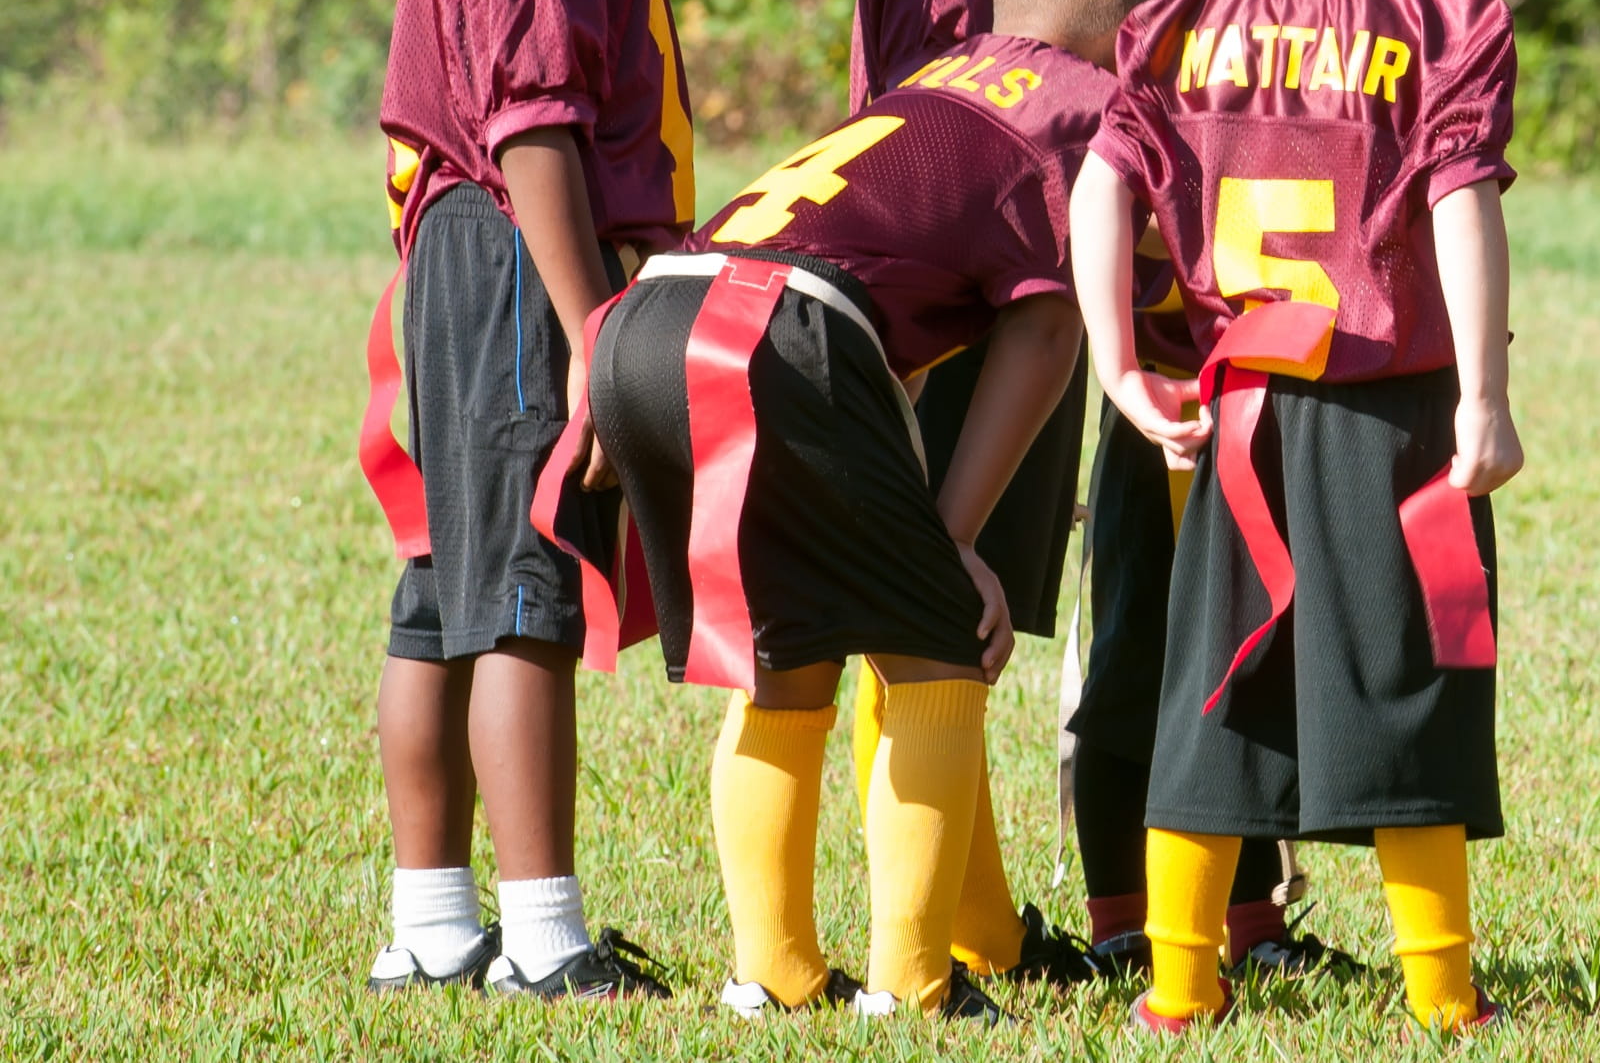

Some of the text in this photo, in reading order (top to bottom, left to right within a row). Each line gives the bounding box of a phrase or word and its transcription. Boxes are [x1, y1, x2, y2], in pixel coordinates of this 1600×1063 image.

[1179, 24, 1411, 104] MATTAIR
[711, 115, 906, 245] 4
[1213, 177, 1340, 382] 5
